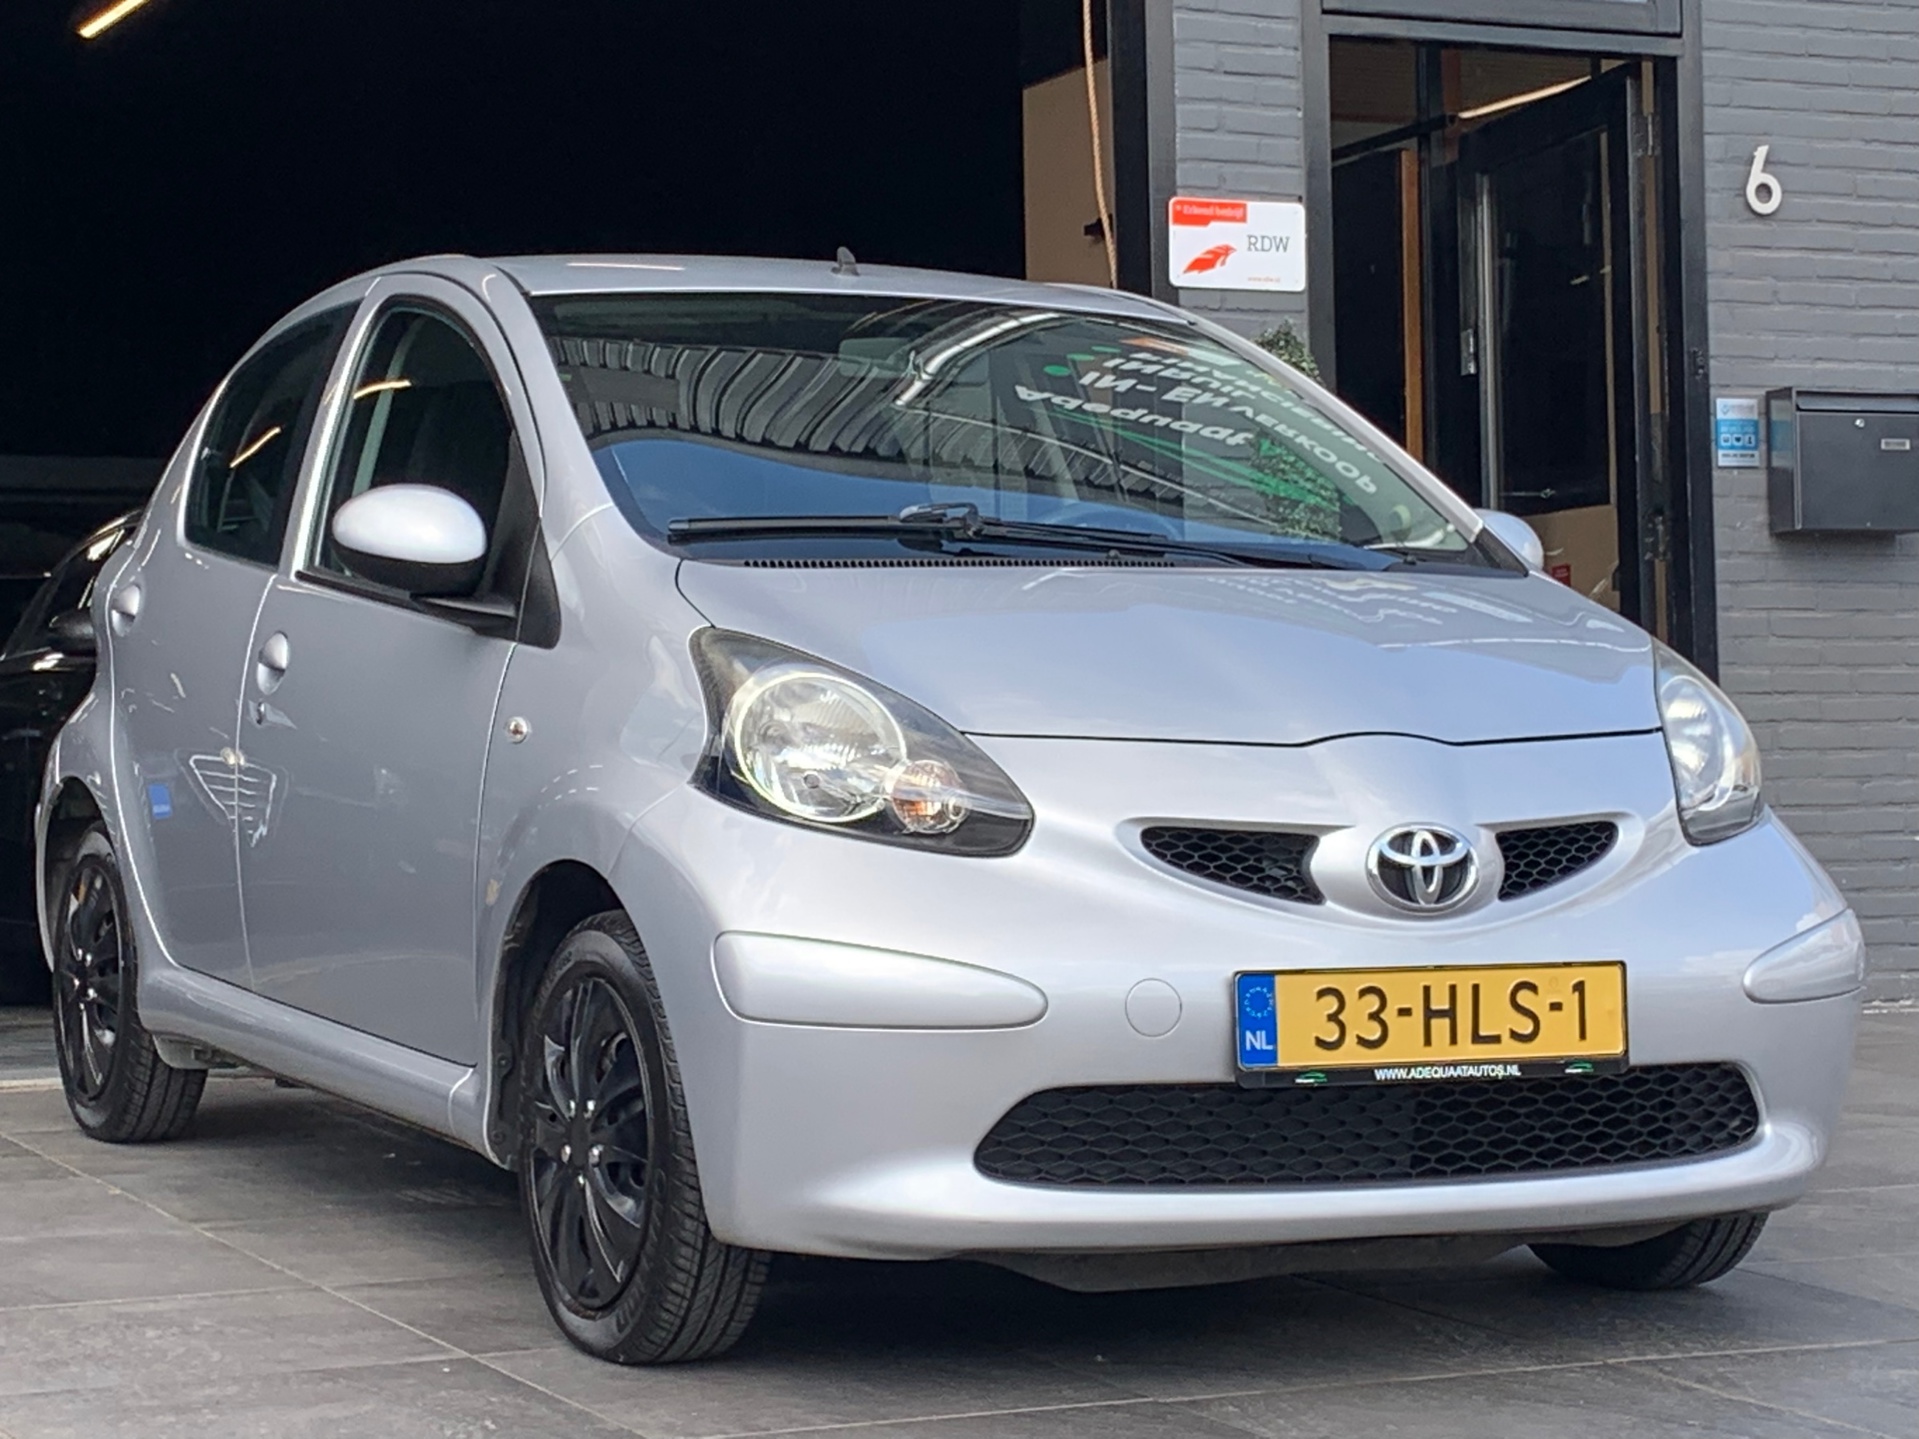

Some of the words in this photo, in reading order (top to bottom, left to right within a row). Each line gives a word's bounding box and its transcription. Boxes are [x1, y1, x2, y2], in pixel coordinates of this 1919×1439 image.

[1745, 144, 1782, 215] 6
[1247, 234, 1290, 252] RDW
[1313, 979, 1588, 1051] 33-HLS-1
[1245, 1029, 1274, 1051] NL
[1373, 1064, 1522, 1081] WWW.ADEQUAATAUTOS.NL
